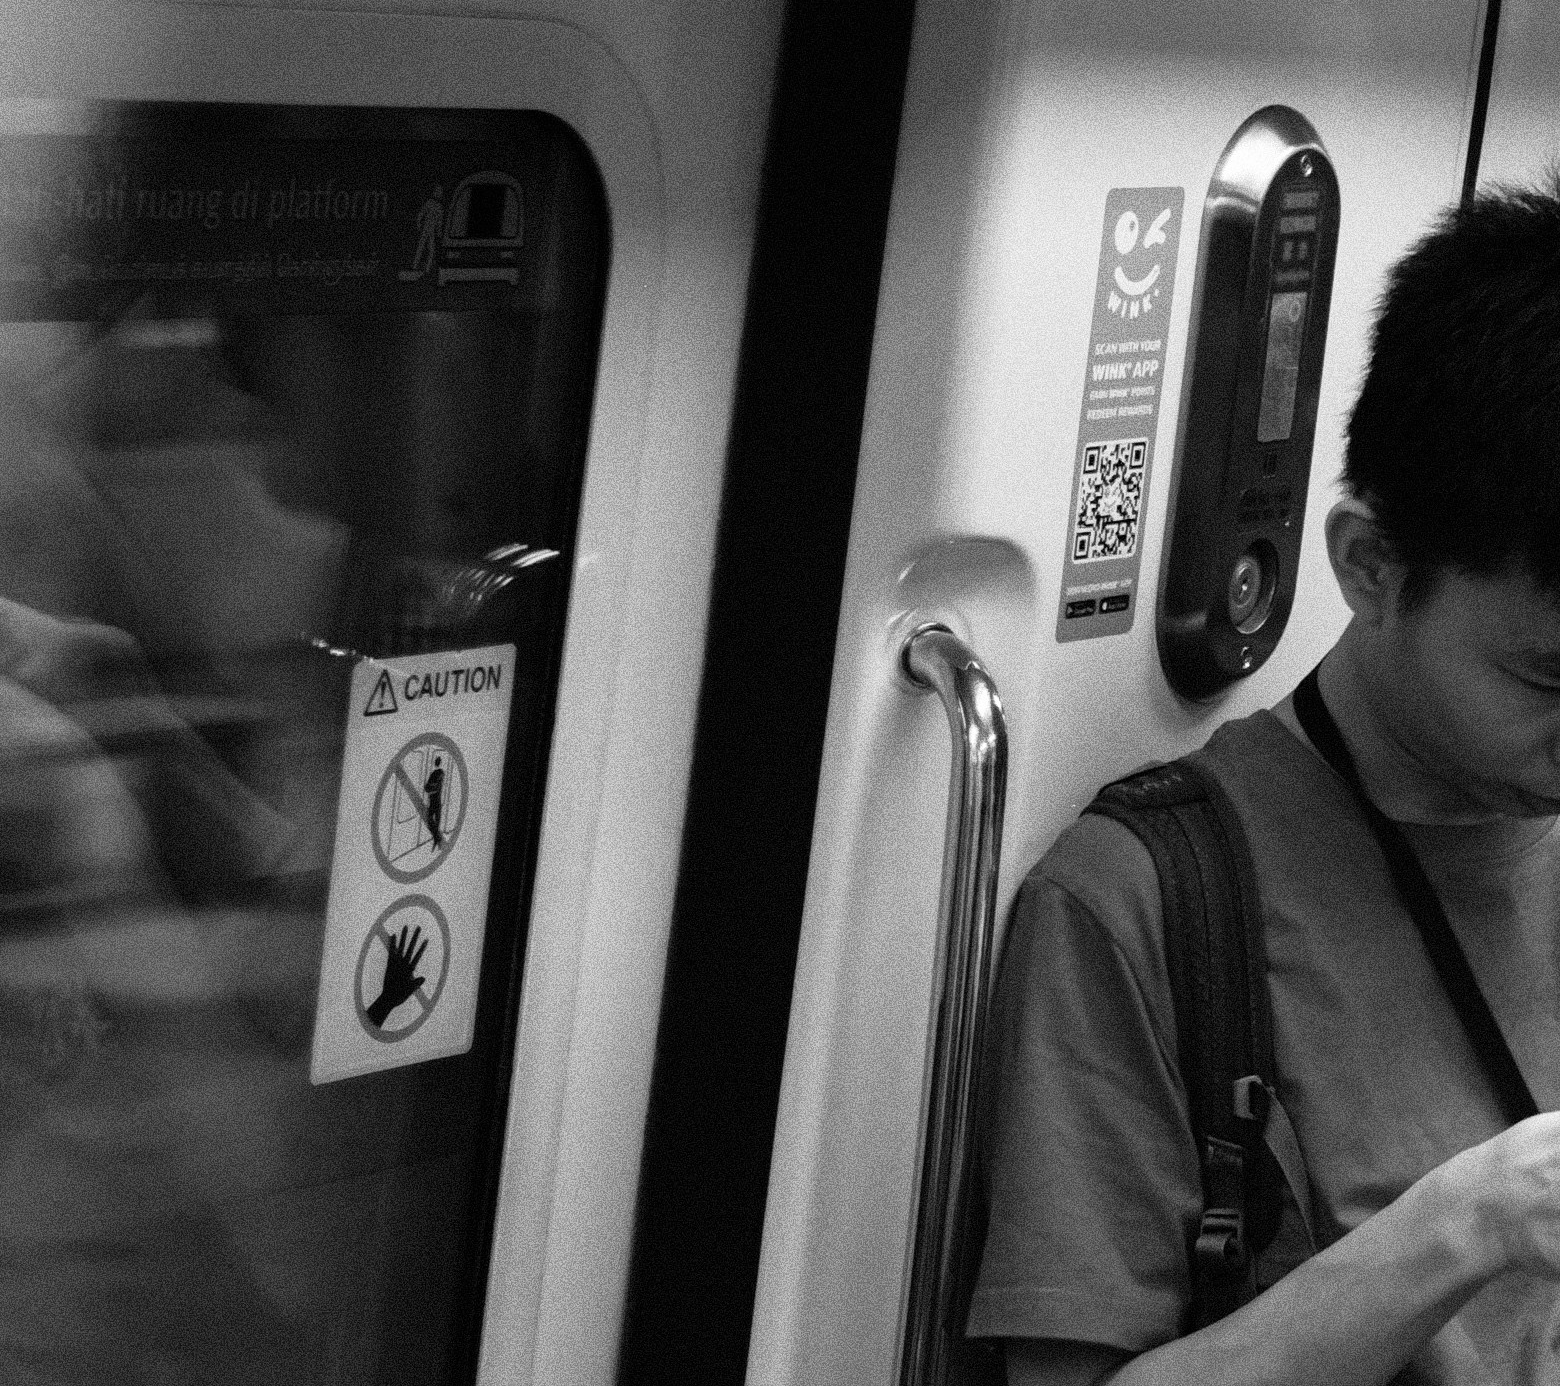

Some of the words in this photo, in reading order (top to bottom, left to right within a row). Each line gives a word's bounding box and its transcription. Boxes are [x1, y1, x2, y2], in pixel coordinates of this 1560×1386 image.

[267, 177, 390, 229] platform
[1132, 359, 1159, 378] APP
[404, 664, 503, 701] CAUTION
